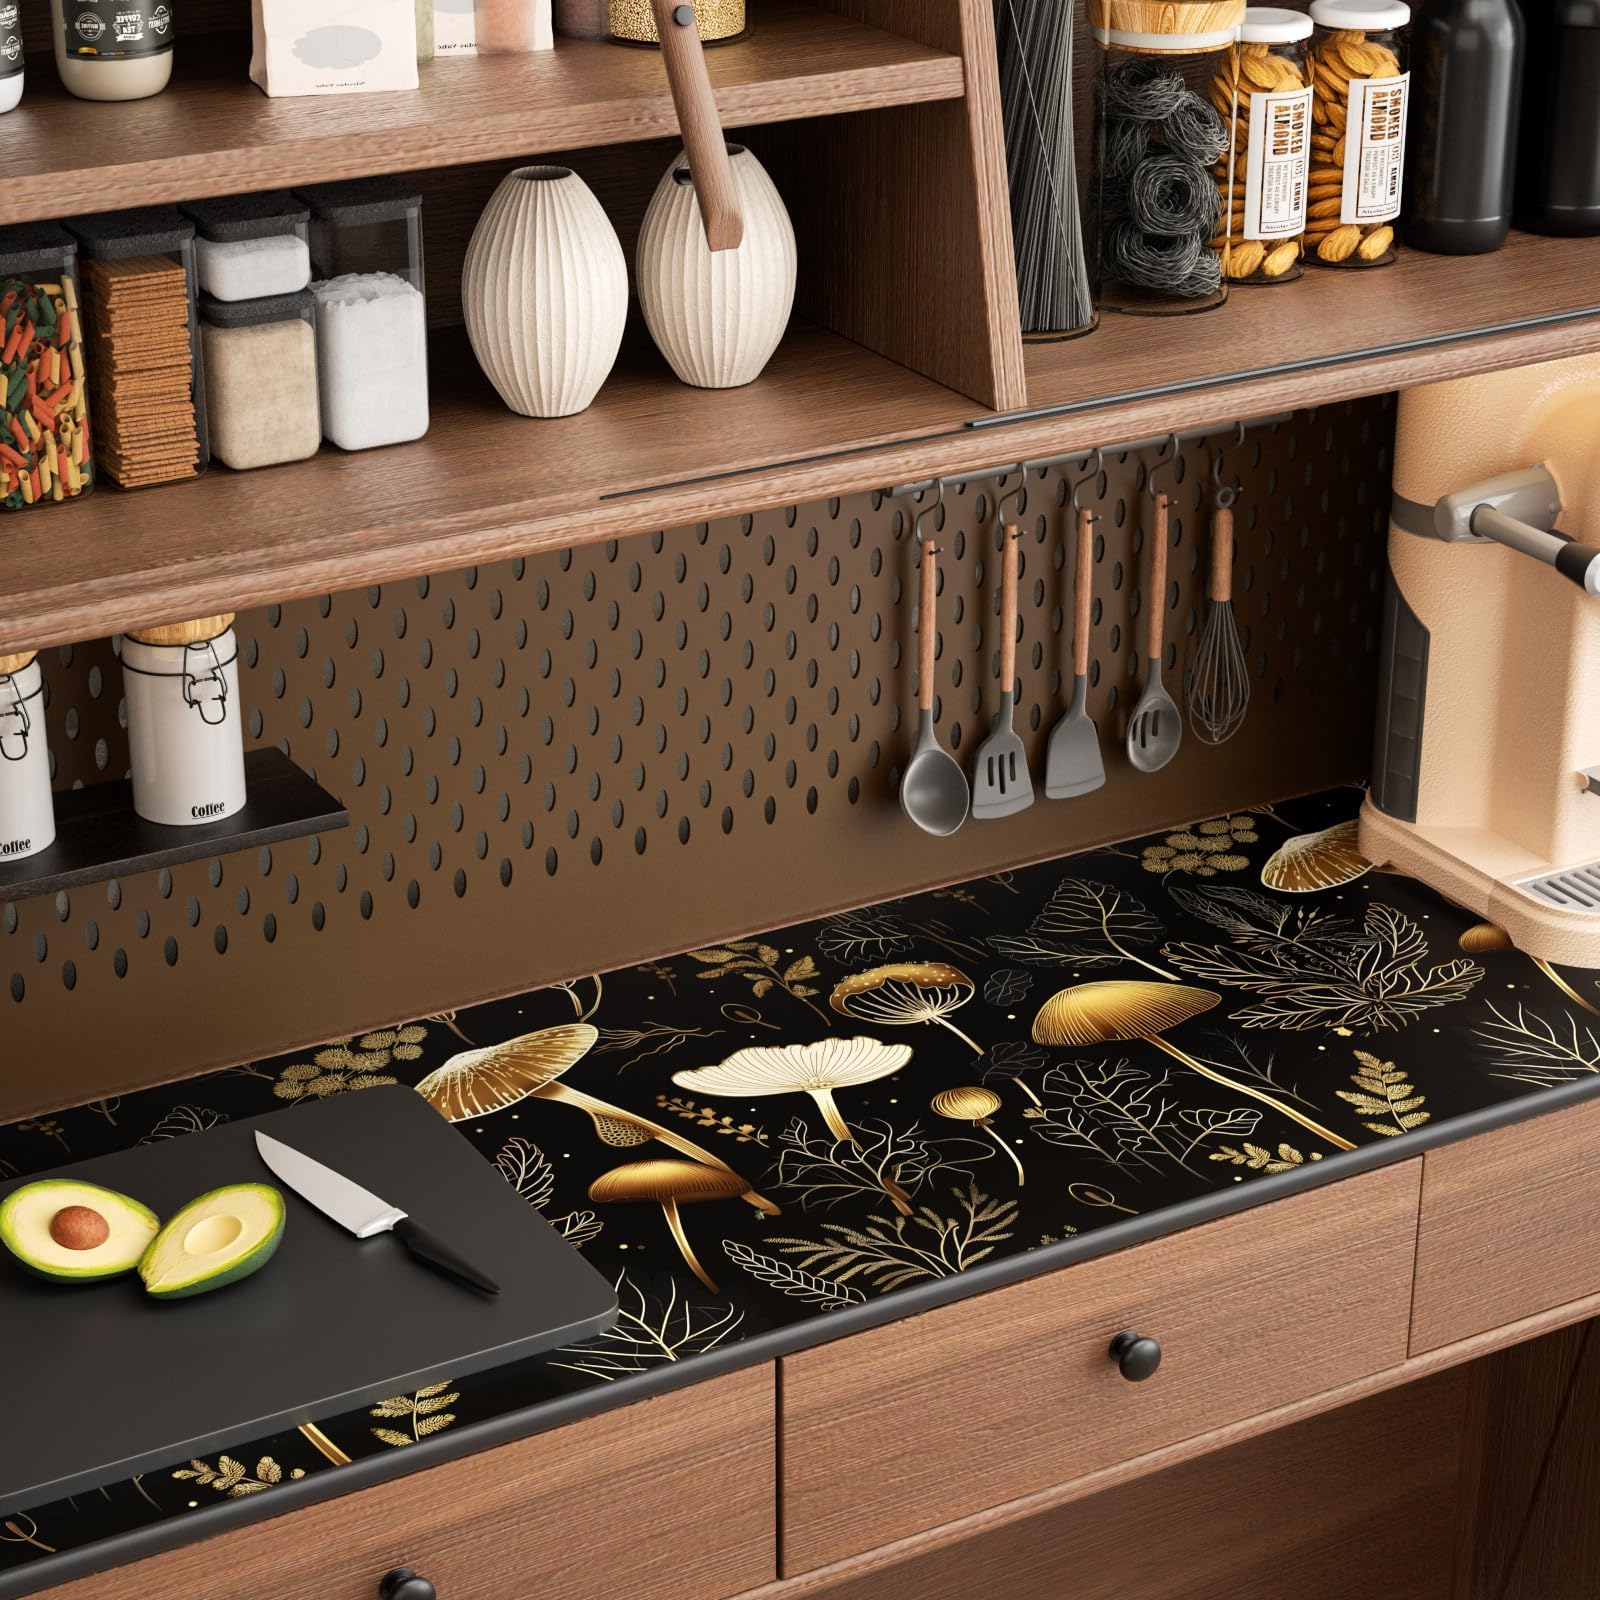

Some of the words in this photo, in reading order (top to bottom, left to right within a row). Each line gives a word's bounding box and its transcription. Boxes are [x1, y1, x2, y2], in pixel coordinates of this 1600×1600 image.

[1272, 105, 1291, 156] ALMOND
[1290, 102, 1305, 154] SMOKED
[1370, 91, 1388, 141] ALMOND
[1387, 88, 1402, 139] SMOKED
[1293, 182, 1302, 211] ALMOND
[1389, 167, 1398, 196] ALMOND
[191, 801, 225, 818] Coffee
